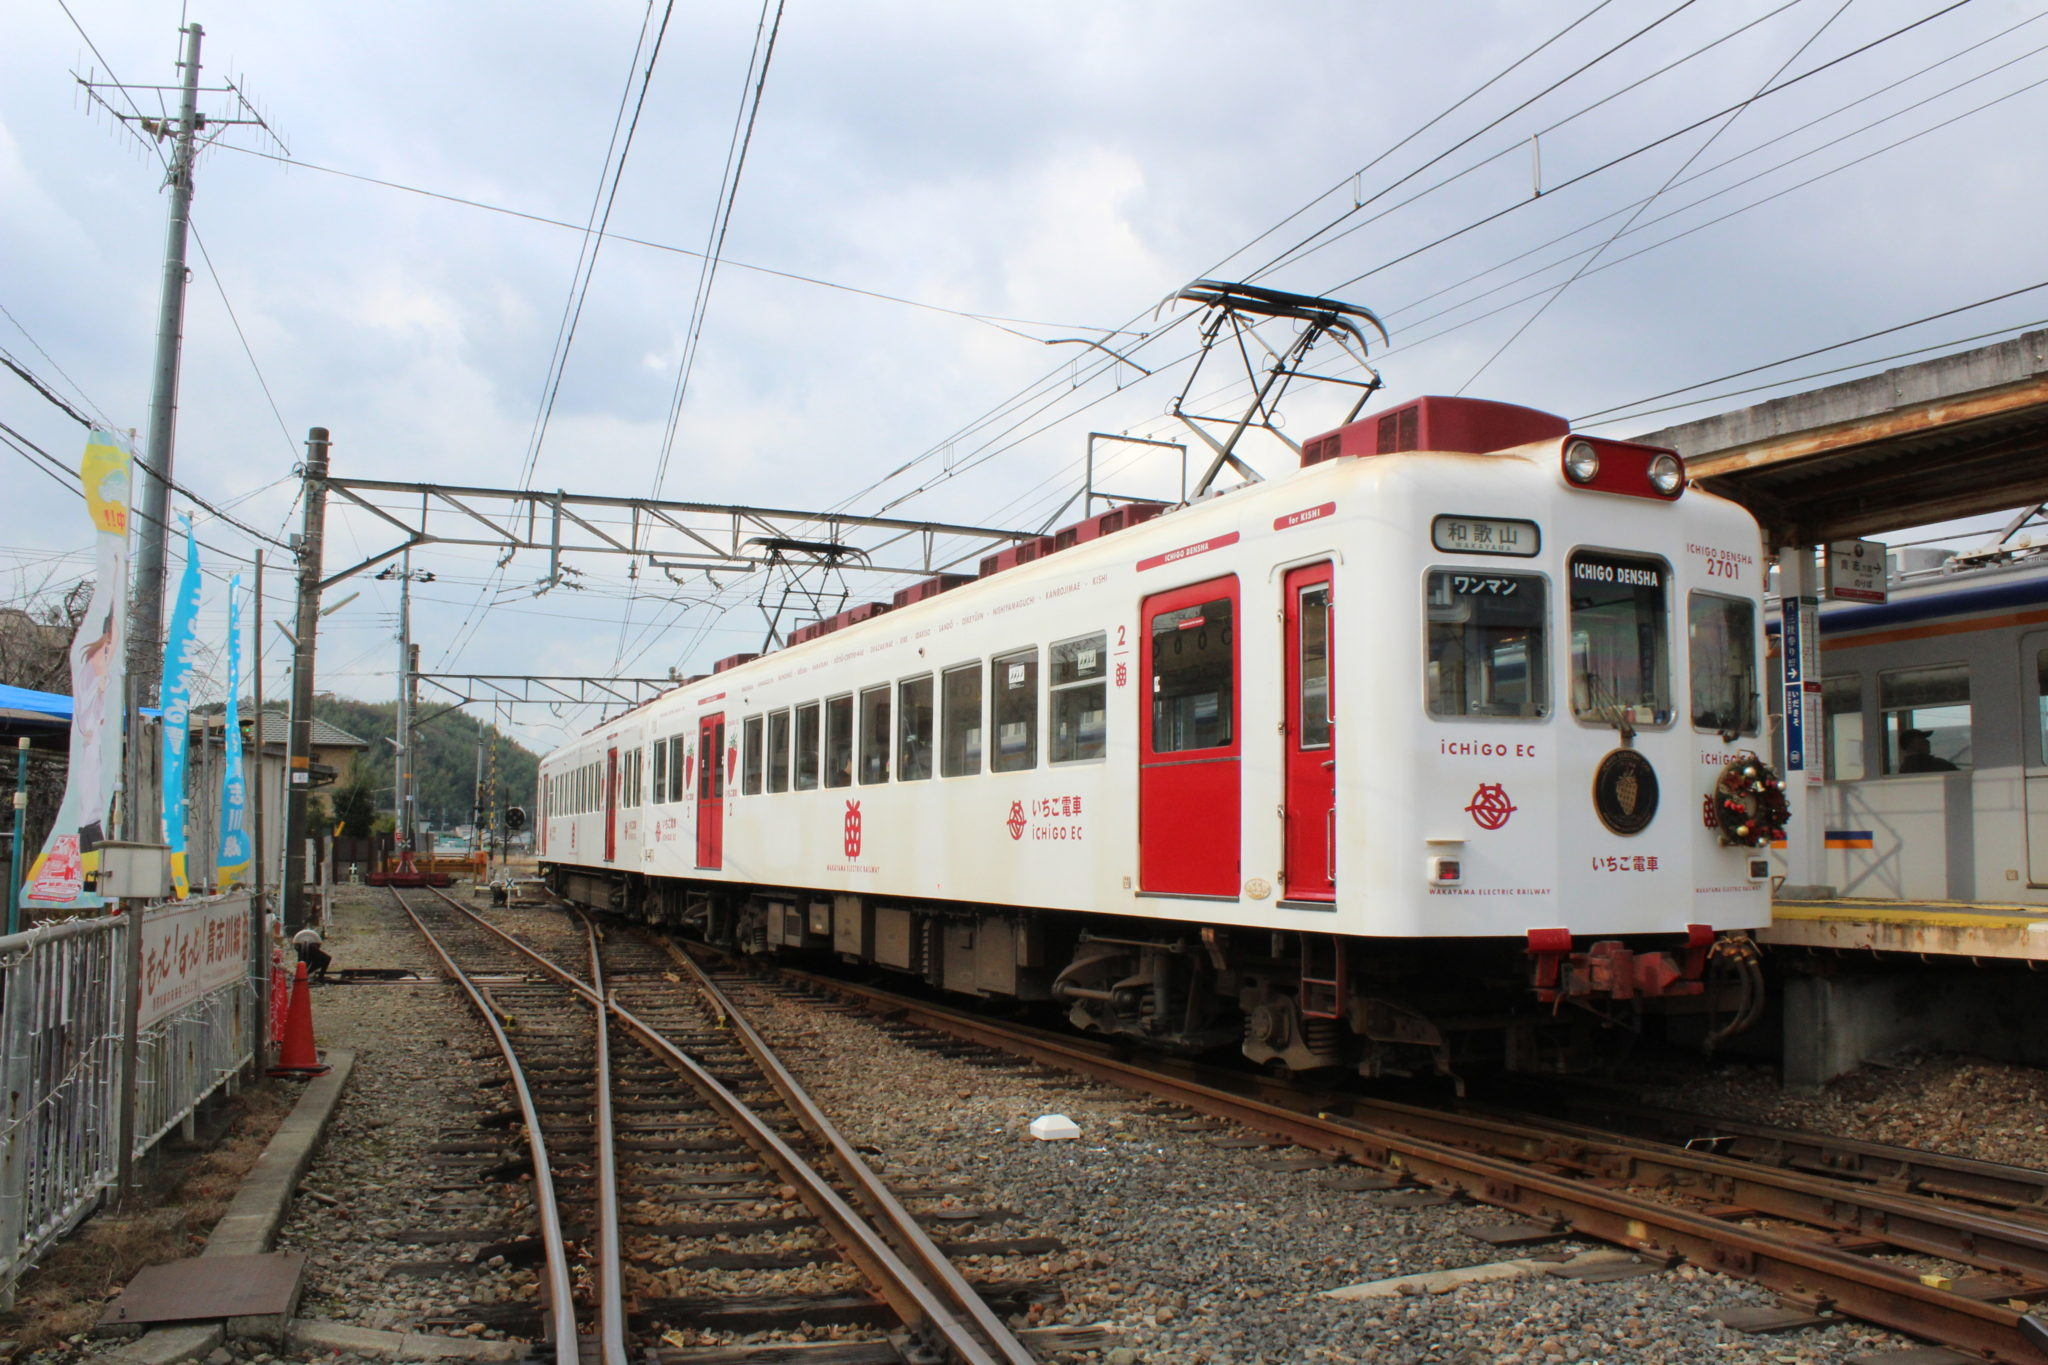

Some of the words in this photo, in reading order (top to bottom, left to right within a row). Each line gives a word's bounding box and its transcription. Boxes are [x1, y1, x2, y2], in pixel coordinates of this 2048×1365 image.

[1288, 515, 1299, 525] for
[1300, 508, 1321, 521] KISHI
[1447, 522, 1518, 545] 和歌山
[1164, 549, 1185, 562] ICHIGO
[1186, 541, 1209, 556] DENSHA
[1455, 542, 1512, 551] WAKAYAMA
[1686, 543, 1717, 558] ICHIGO
[1720, 551, 1753, 565] DENSHA
[1574, 562, 1614, 583] ICHIGO
[1617, 567, 1659, 587] DENSHA
[1707, 558, 1740, 580] 2701
[1045, 581, 1081, 599] KANROJIMAE
[1092, 573, 1108, 585] KISHI
[1453, 576, 1518, 596] ワンマン
[1117, 624, 1126, 647] 2
[1516, 744, 1535, 757] EC
[1032, 795, 1082, 818] いちご電車
[1071, 826, 1082, 840] EC
[1592, 855, 1659, 872] いちご電車
[1429, 888, 1475, 896] WAKAYAMA
[1478, 888, 1514, 896] ELECTRIC
